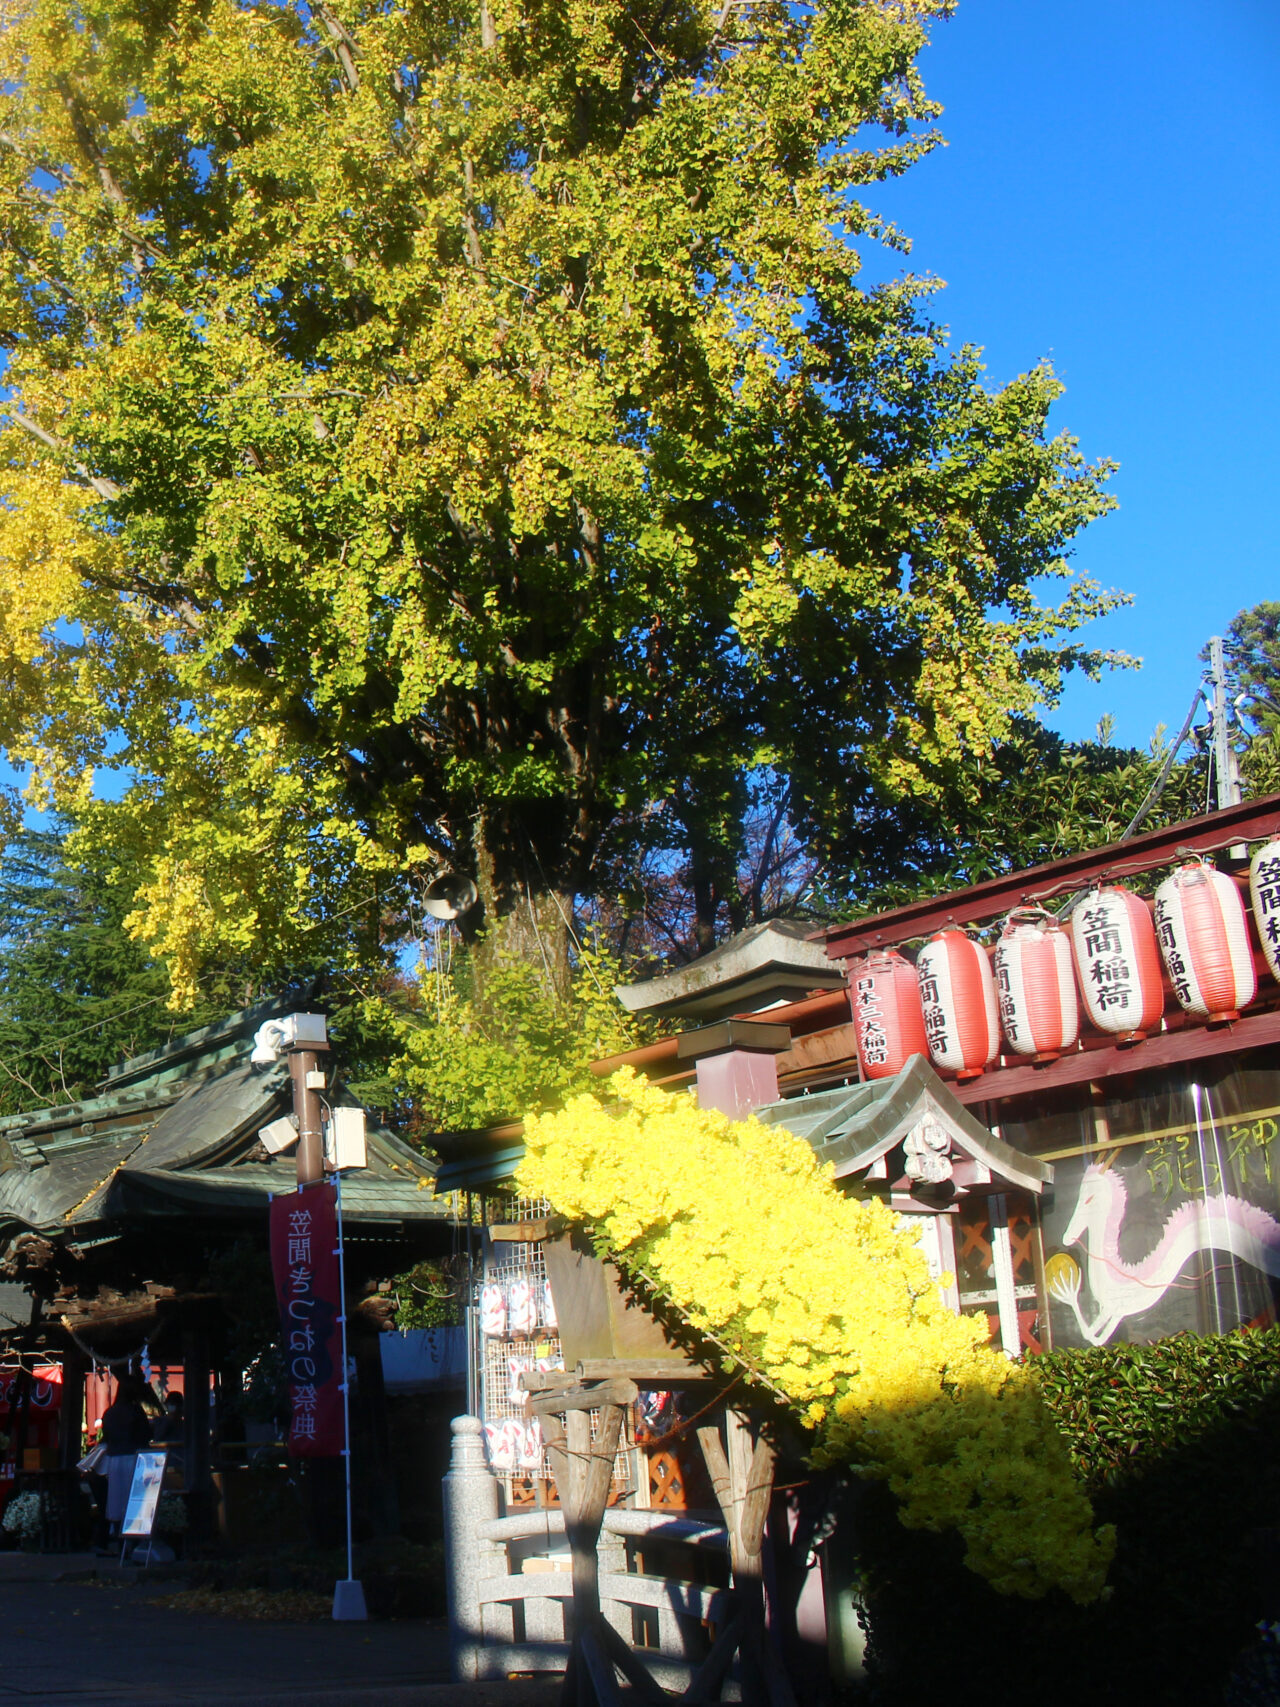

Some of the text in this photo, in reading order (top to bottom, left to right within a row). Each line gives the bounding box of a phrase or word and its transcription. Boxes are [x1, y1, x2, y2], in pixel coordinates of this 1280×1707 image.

[1081, 902, 1132, 1011] 笠間稲荷
[1153, 898, 1191, 1003] 笠間稲荷
[1256, 857, 1280, 971] 笠間
[856, 978, 888, 1065] 日本三大稲荷
[919, 956, 949, 1055] 笠間稲荷
[994, 946, 1019, 1041] 笠間稲荷
